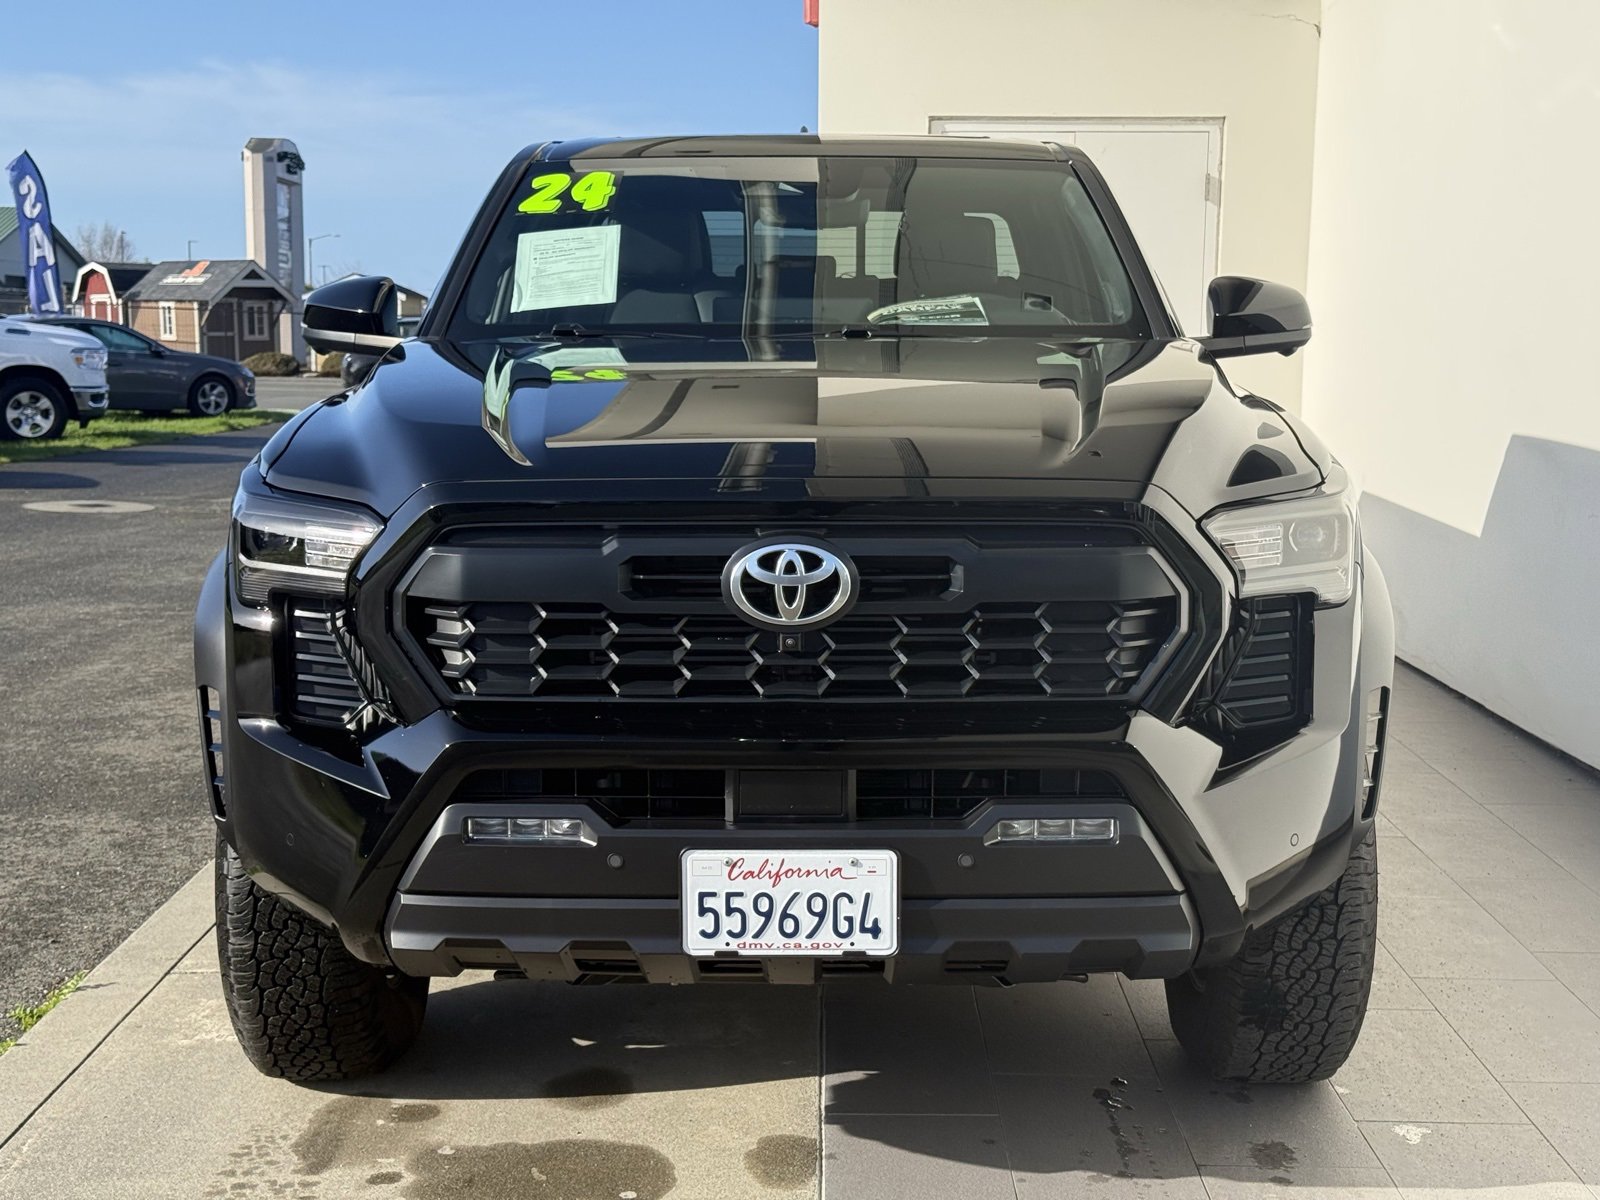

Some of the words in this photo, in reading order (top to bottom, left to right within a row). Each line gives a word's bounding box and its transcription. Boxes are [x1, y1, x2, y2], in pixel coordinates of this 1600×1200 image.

[517, 171, 616, 214] 24
[727, 857, 857, 888] California
[697, 891, 882, 939] 55969G4
[736, 941, 844, 949] dmv.ca.gov
